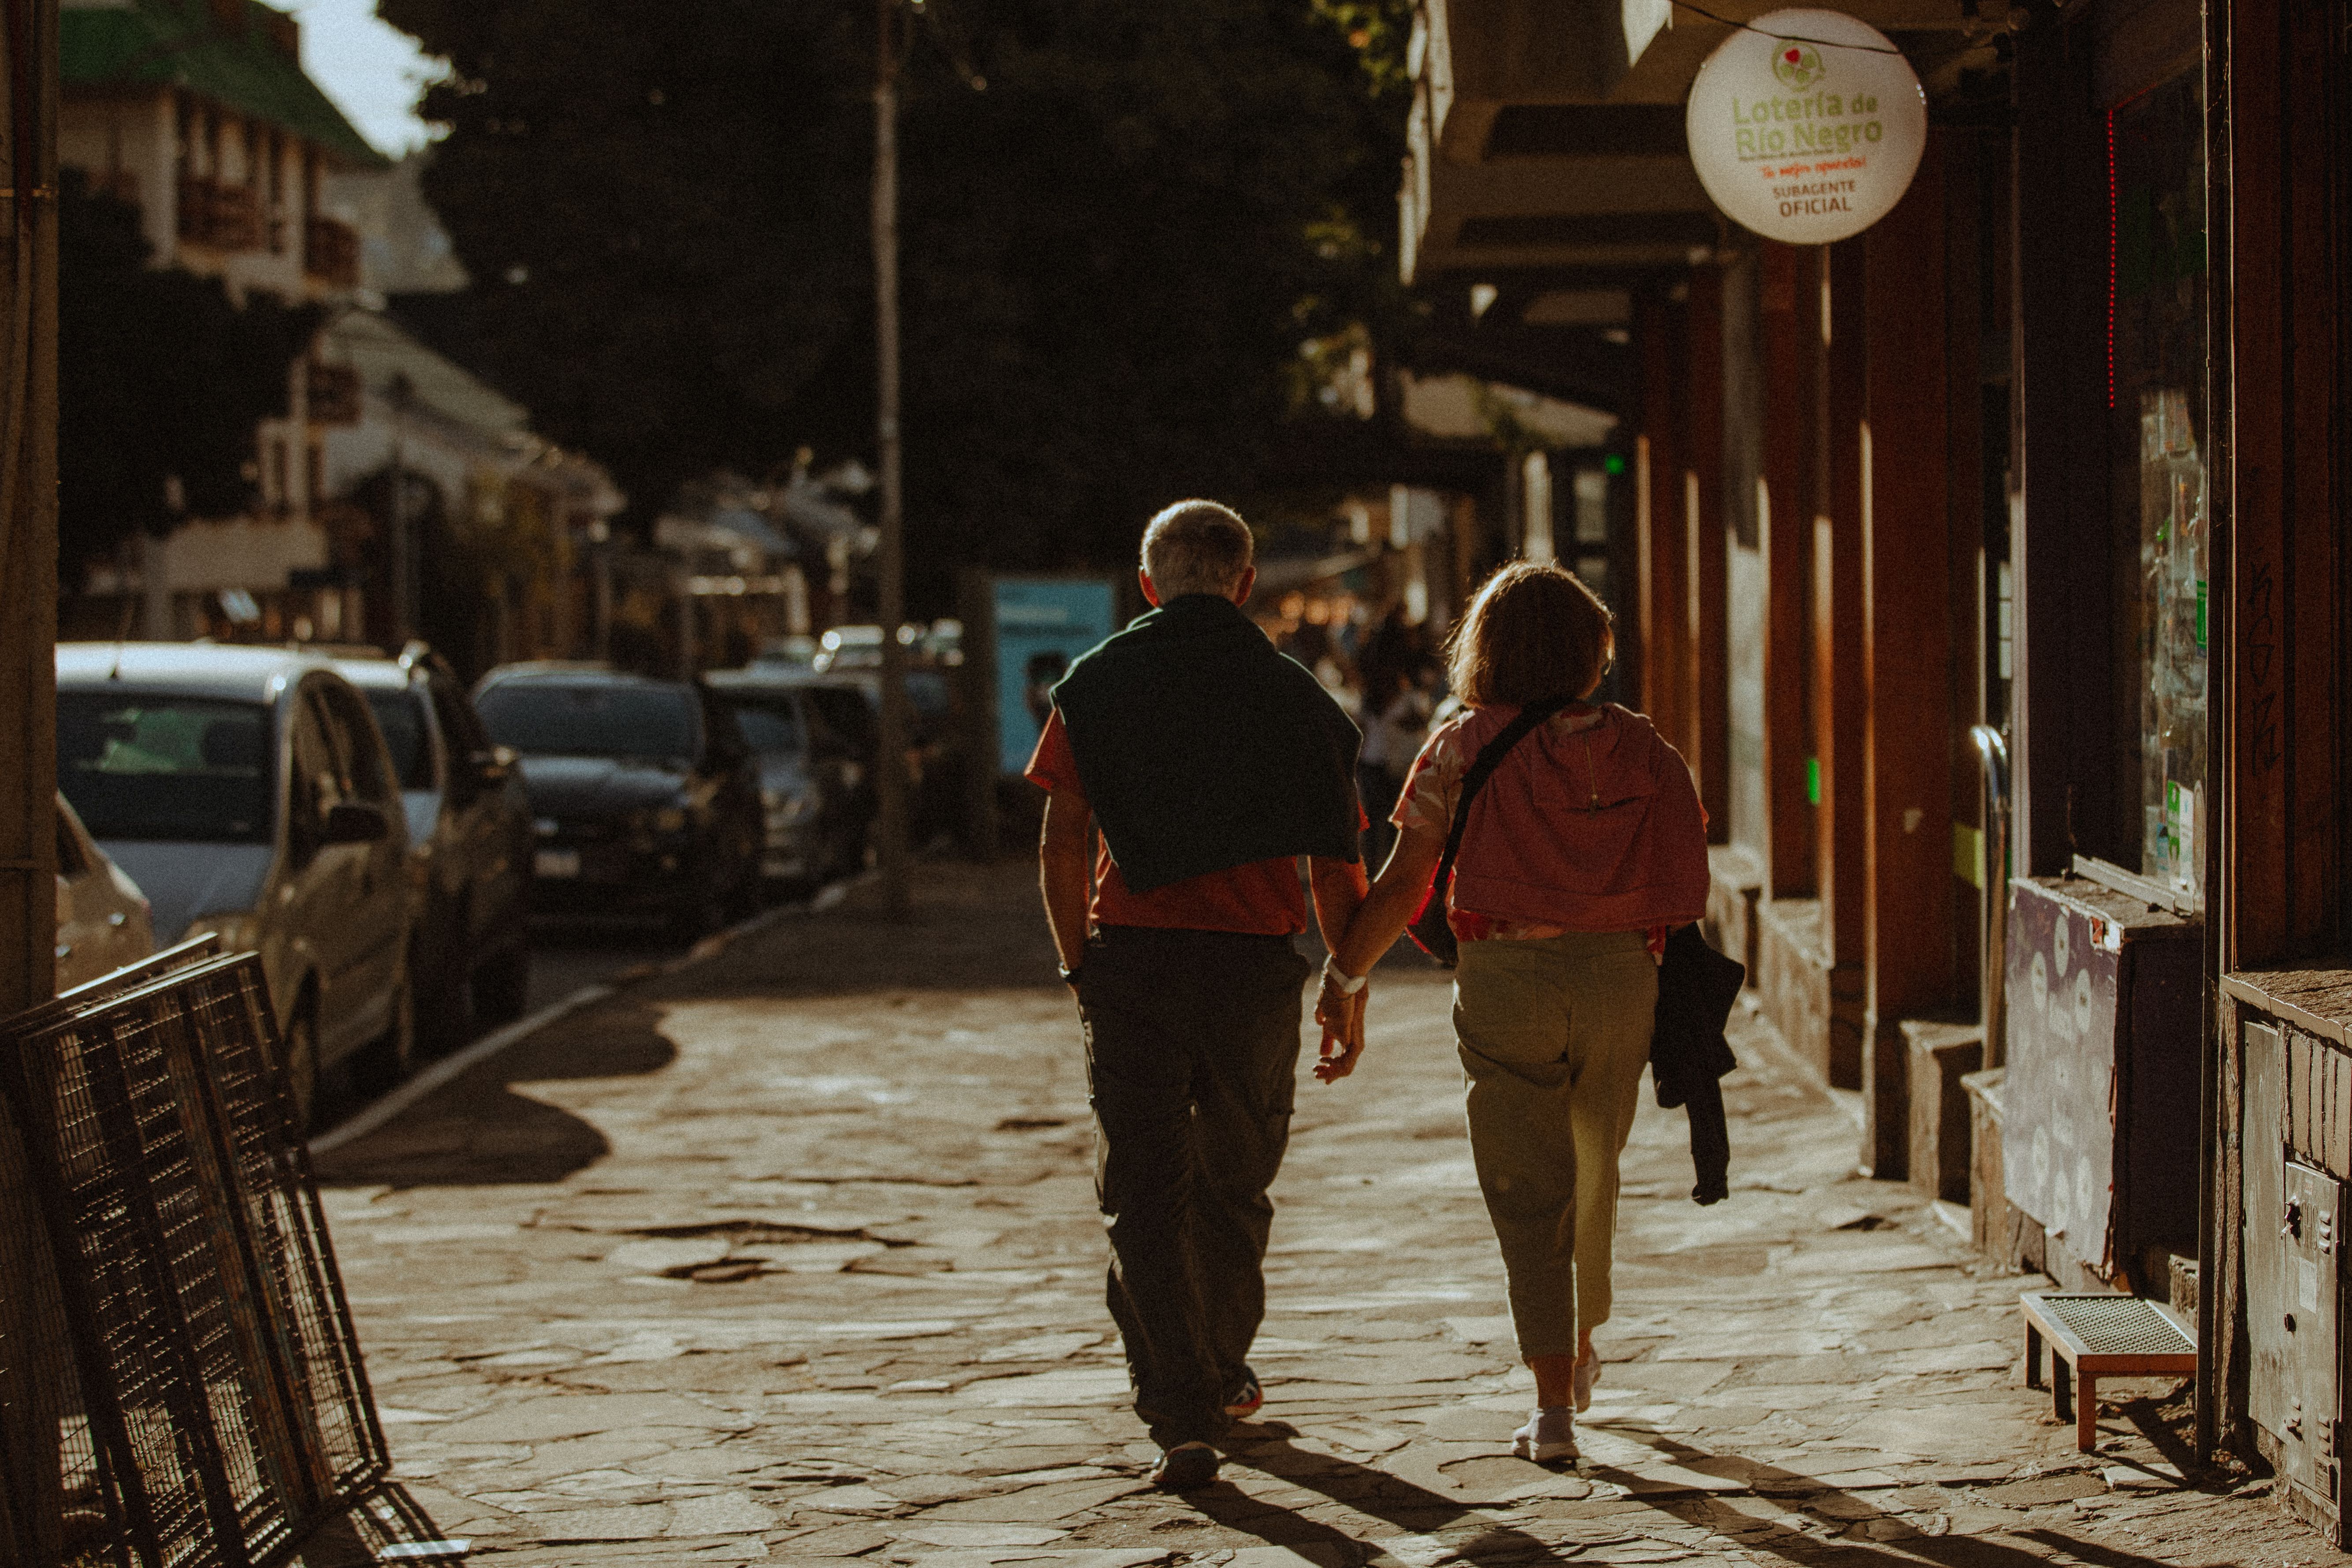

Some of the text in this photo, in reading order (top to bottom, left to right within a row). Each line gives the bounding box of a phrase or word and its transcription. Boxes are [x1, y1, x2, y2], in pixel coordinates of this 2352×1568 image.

[1732, 91, 1878, 124] Lotería de
[1735, 120, 1883, 153] Río Negro
[1772, 179, 1855, 199] SUBAGENTE
[1779, 197, 1852, 217] OFICIAL
